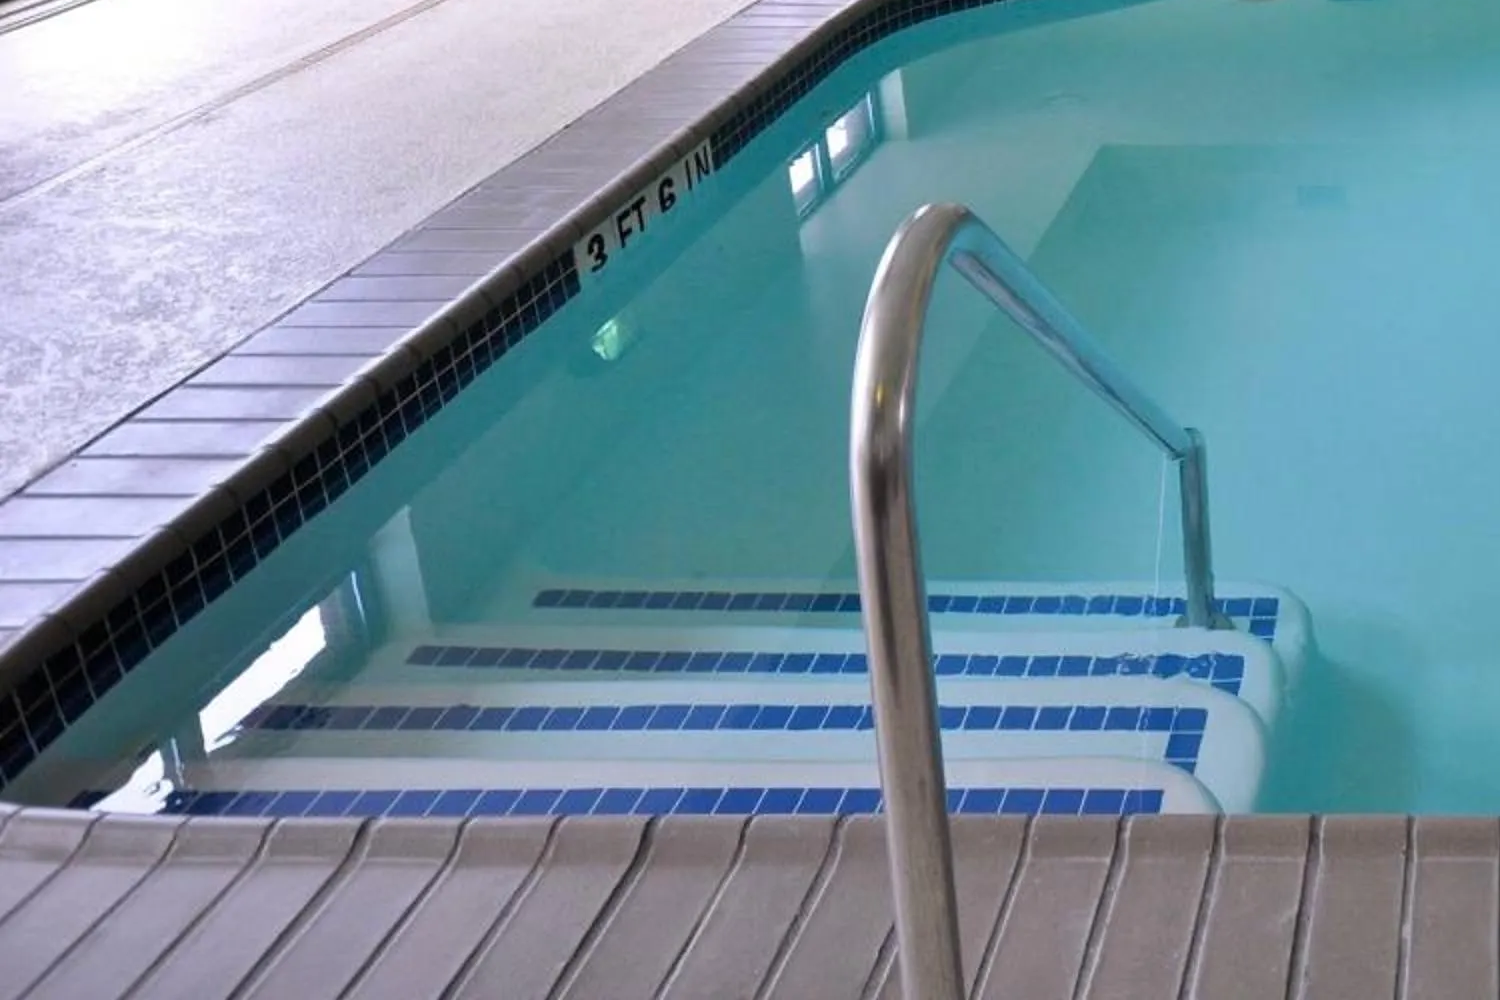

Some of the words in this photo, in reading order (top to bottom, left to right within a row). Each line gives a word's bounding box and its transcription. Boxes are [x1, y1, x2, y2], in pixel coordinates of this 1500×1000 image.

[587, 233, 608, 273] 3
[616, 195, 646, 249] FT
[658, 176, 676, 213] 6
[684, 145, 711, 192] IN
